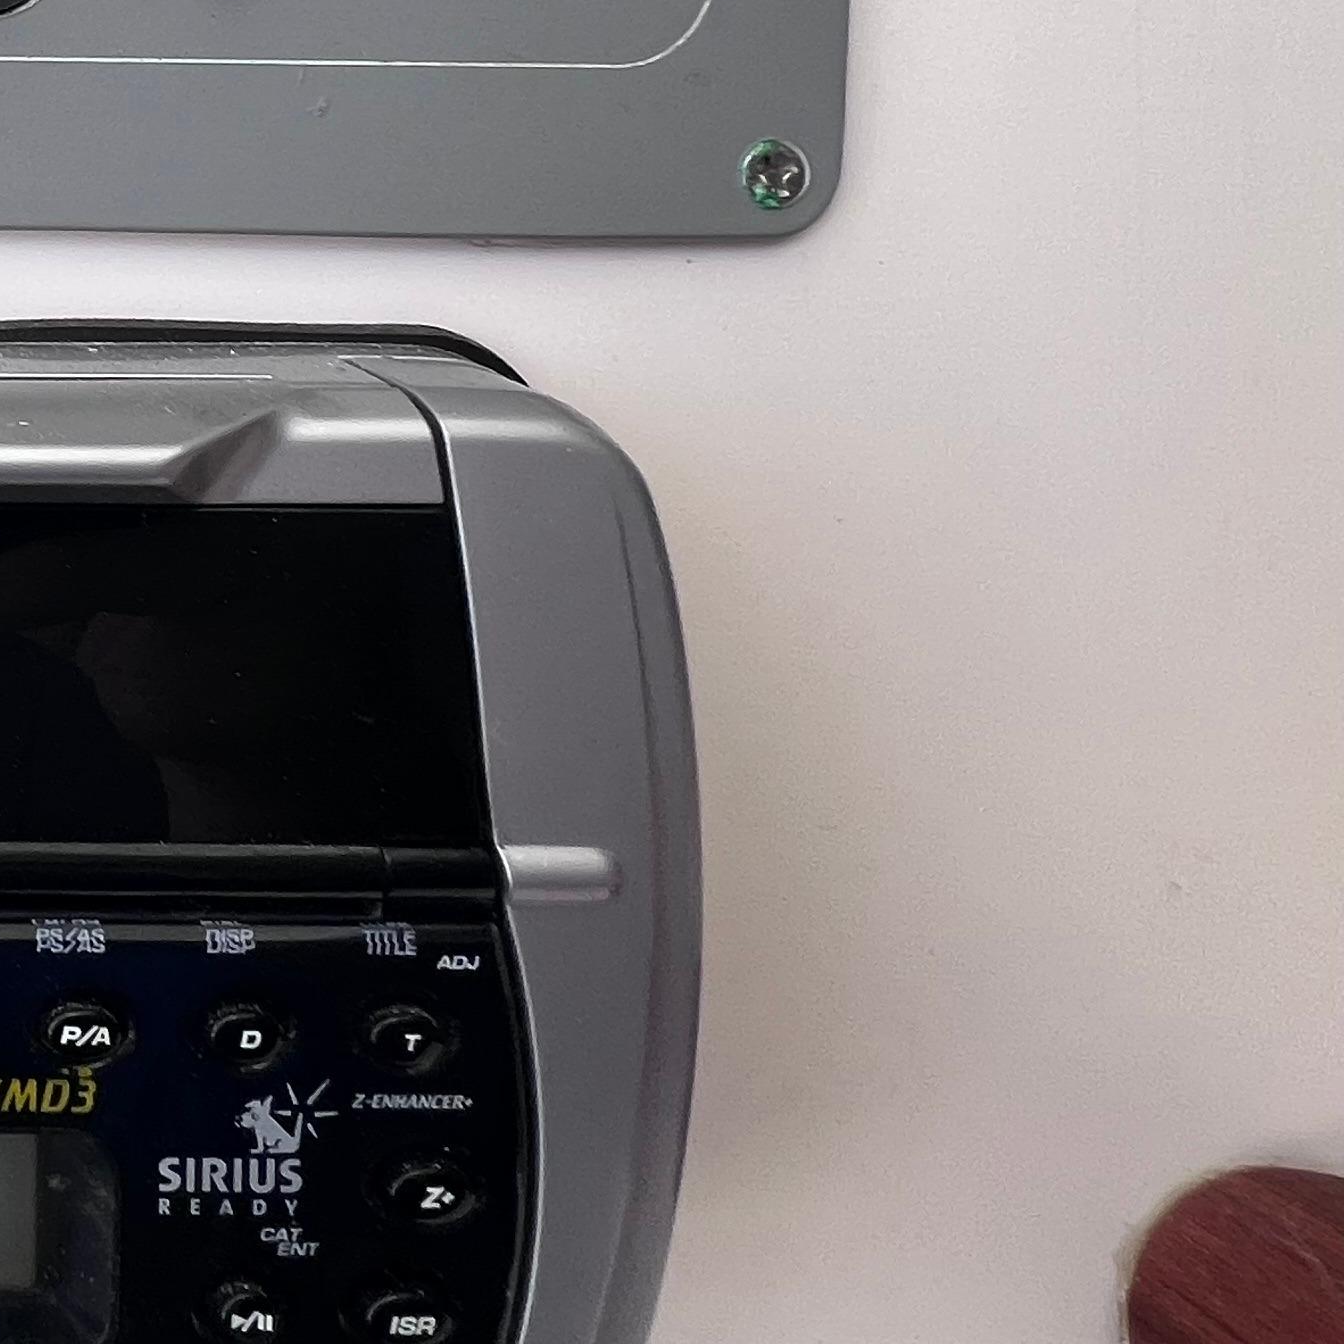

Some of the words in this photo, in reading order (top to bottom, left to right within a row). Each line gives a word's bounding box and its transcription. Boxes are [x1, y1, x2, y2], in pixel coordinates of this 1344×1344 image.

[436, 954, 480, 971] ADJ
[60, 1025, 111, 1047] P/A
[239, 1030, 262, 1049] D
[404, 1033, 422, 1052] T
[158, 1157, 304, 1194] SIRIUS
[158, 1198, 299, 1216] READY
[260, 1227, 303, 1242] CAT
[277, 1242, 320, 1256] ENT
[389, 1316, 436, 1336] ISR
